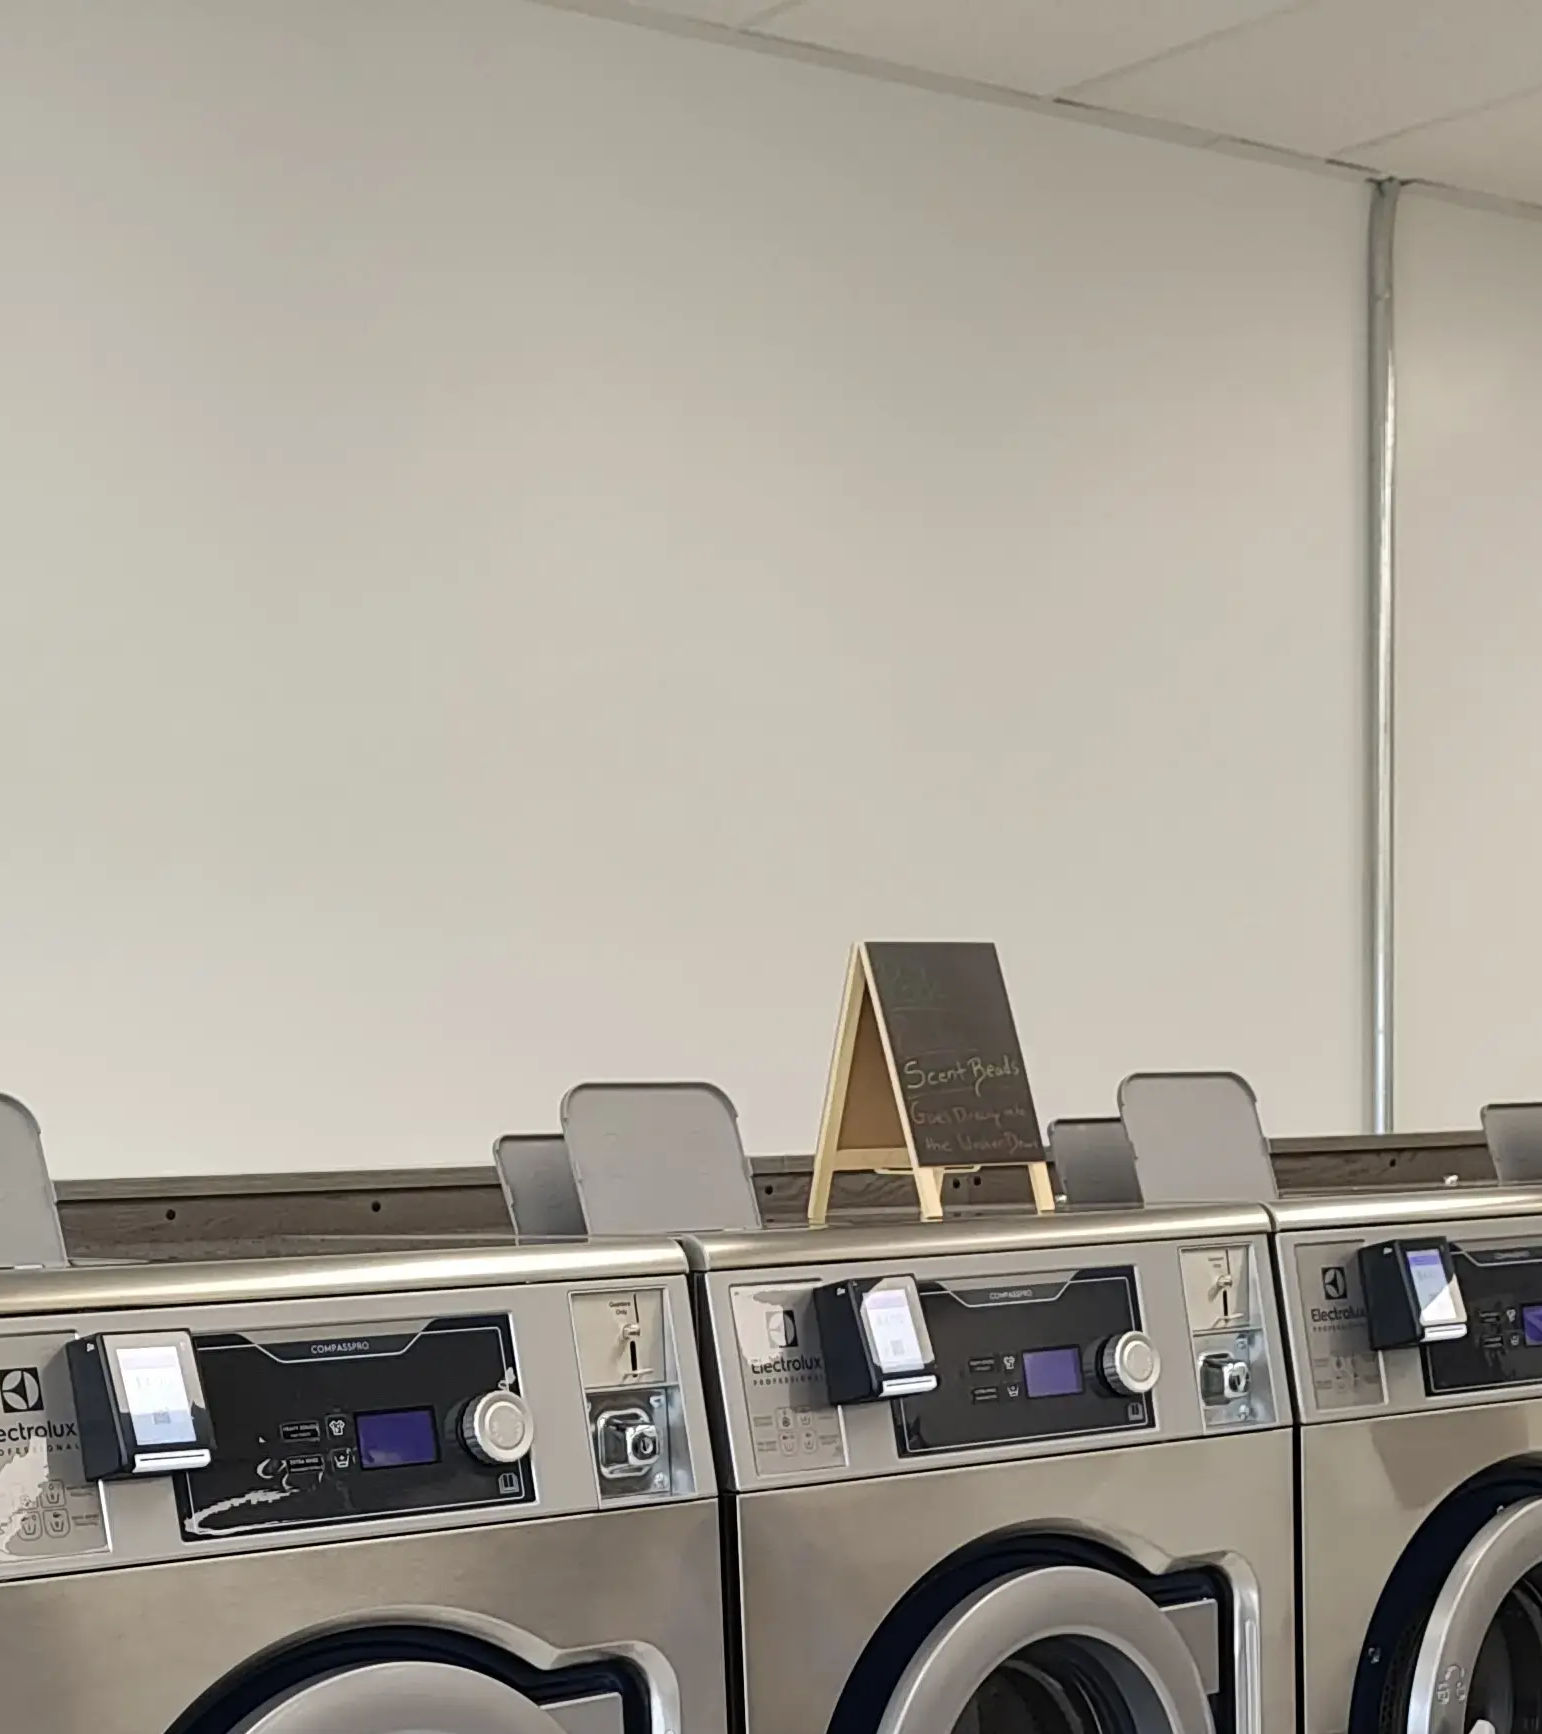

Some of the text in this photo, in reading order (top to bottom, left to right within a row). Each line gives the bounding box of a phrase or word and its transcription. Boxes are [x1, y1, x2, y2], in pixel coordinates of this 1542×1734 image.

[903, 1055, 1021, 1096] Scent Beads
[310, 1340, 370, 1354] COMPASSPRO
[751, 1356, 822, 1375] Electrolux
